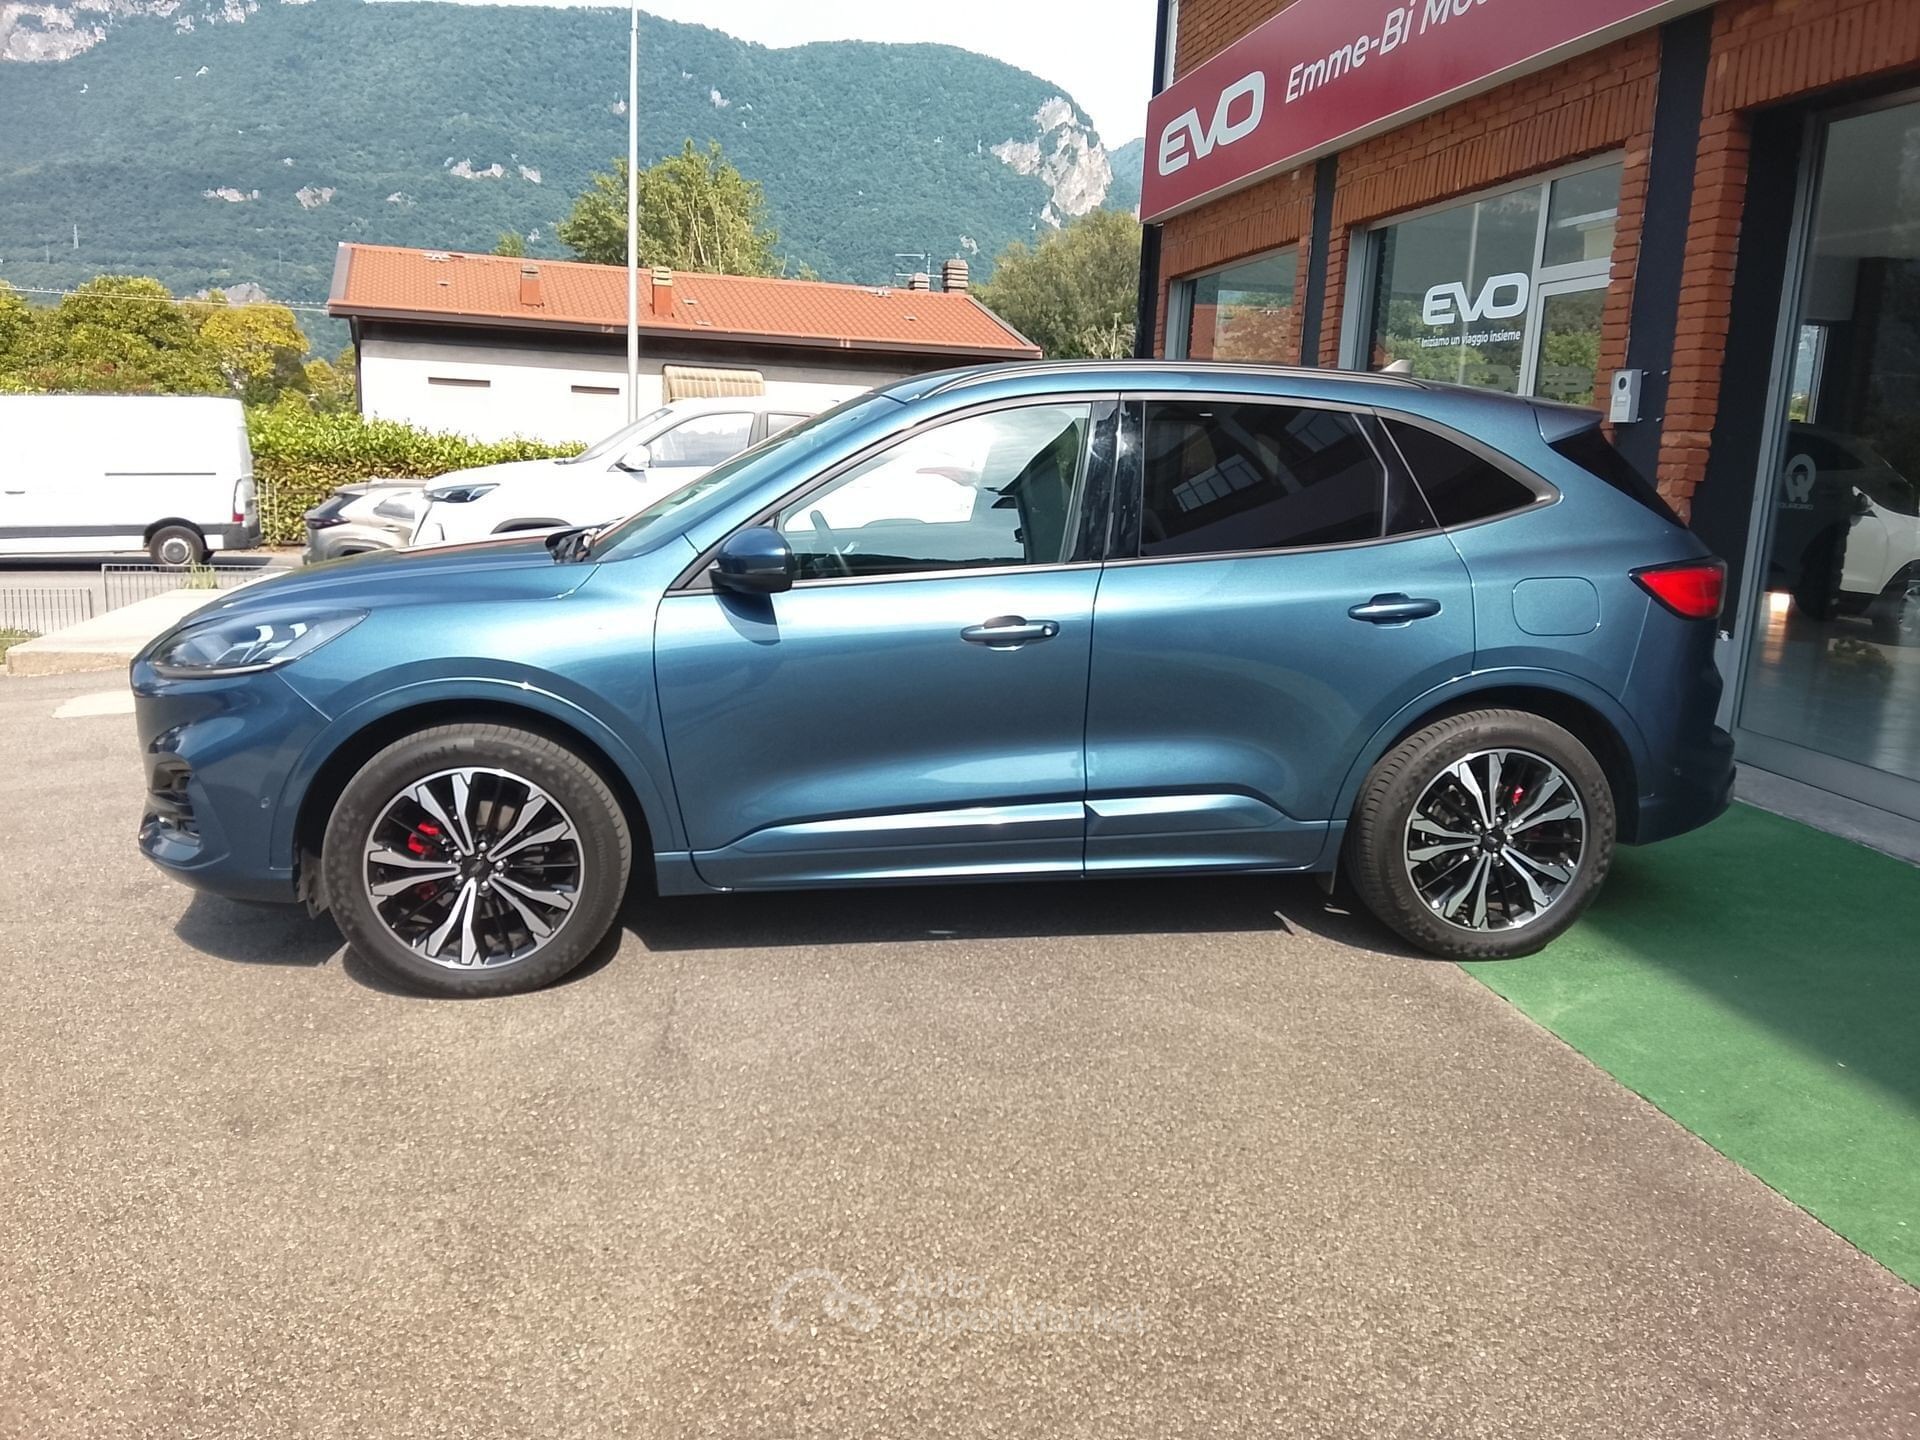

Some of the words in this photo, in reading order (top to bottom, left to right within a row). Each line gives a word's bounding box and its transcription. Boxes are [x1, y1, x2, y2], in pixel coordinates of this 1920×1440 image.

[1285, 0, 1416, 104] Emme-Bi
[1158, 70, 1265, 176] EVO
[1422, 272, 1530, 326] EVO
[1450, 335, 1460, 345] un
[1461, 331, 1489, 346] viaggio
[1489, 328, 1521, 343] insieme
